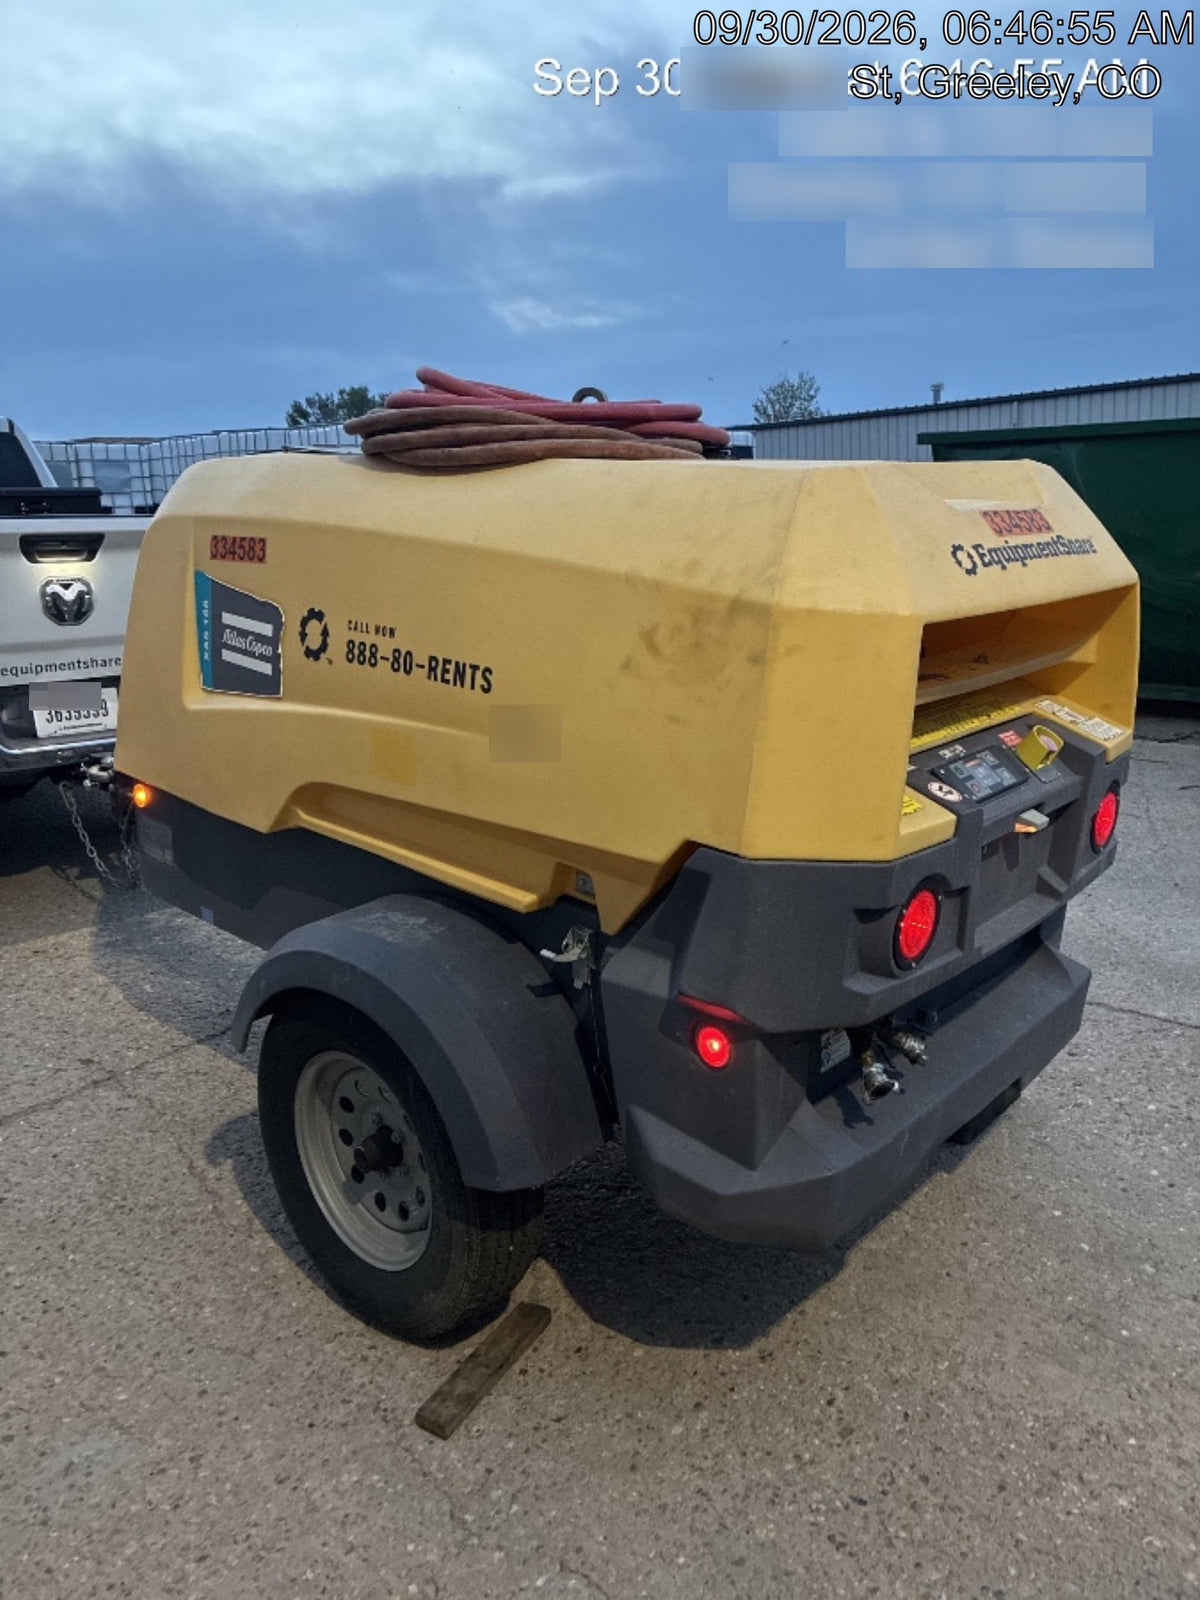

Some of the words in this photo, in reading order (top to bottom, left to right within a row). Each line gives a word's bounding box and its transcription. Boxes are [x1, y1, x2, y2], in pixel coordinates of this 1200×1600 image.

[981, 508, 1052, 534] 334583
[210, 535, 267, 562] 334583
[347, 619, 370, 634] CALL
[374, 624, 397, 639] NOW
[222, 628, 246, 650] Atlas
[246, 636, 273, 657] Copco
[0, 656, 122, 678] equipmentshare
[345, 639, 494, 694] 888-80-RENTS
